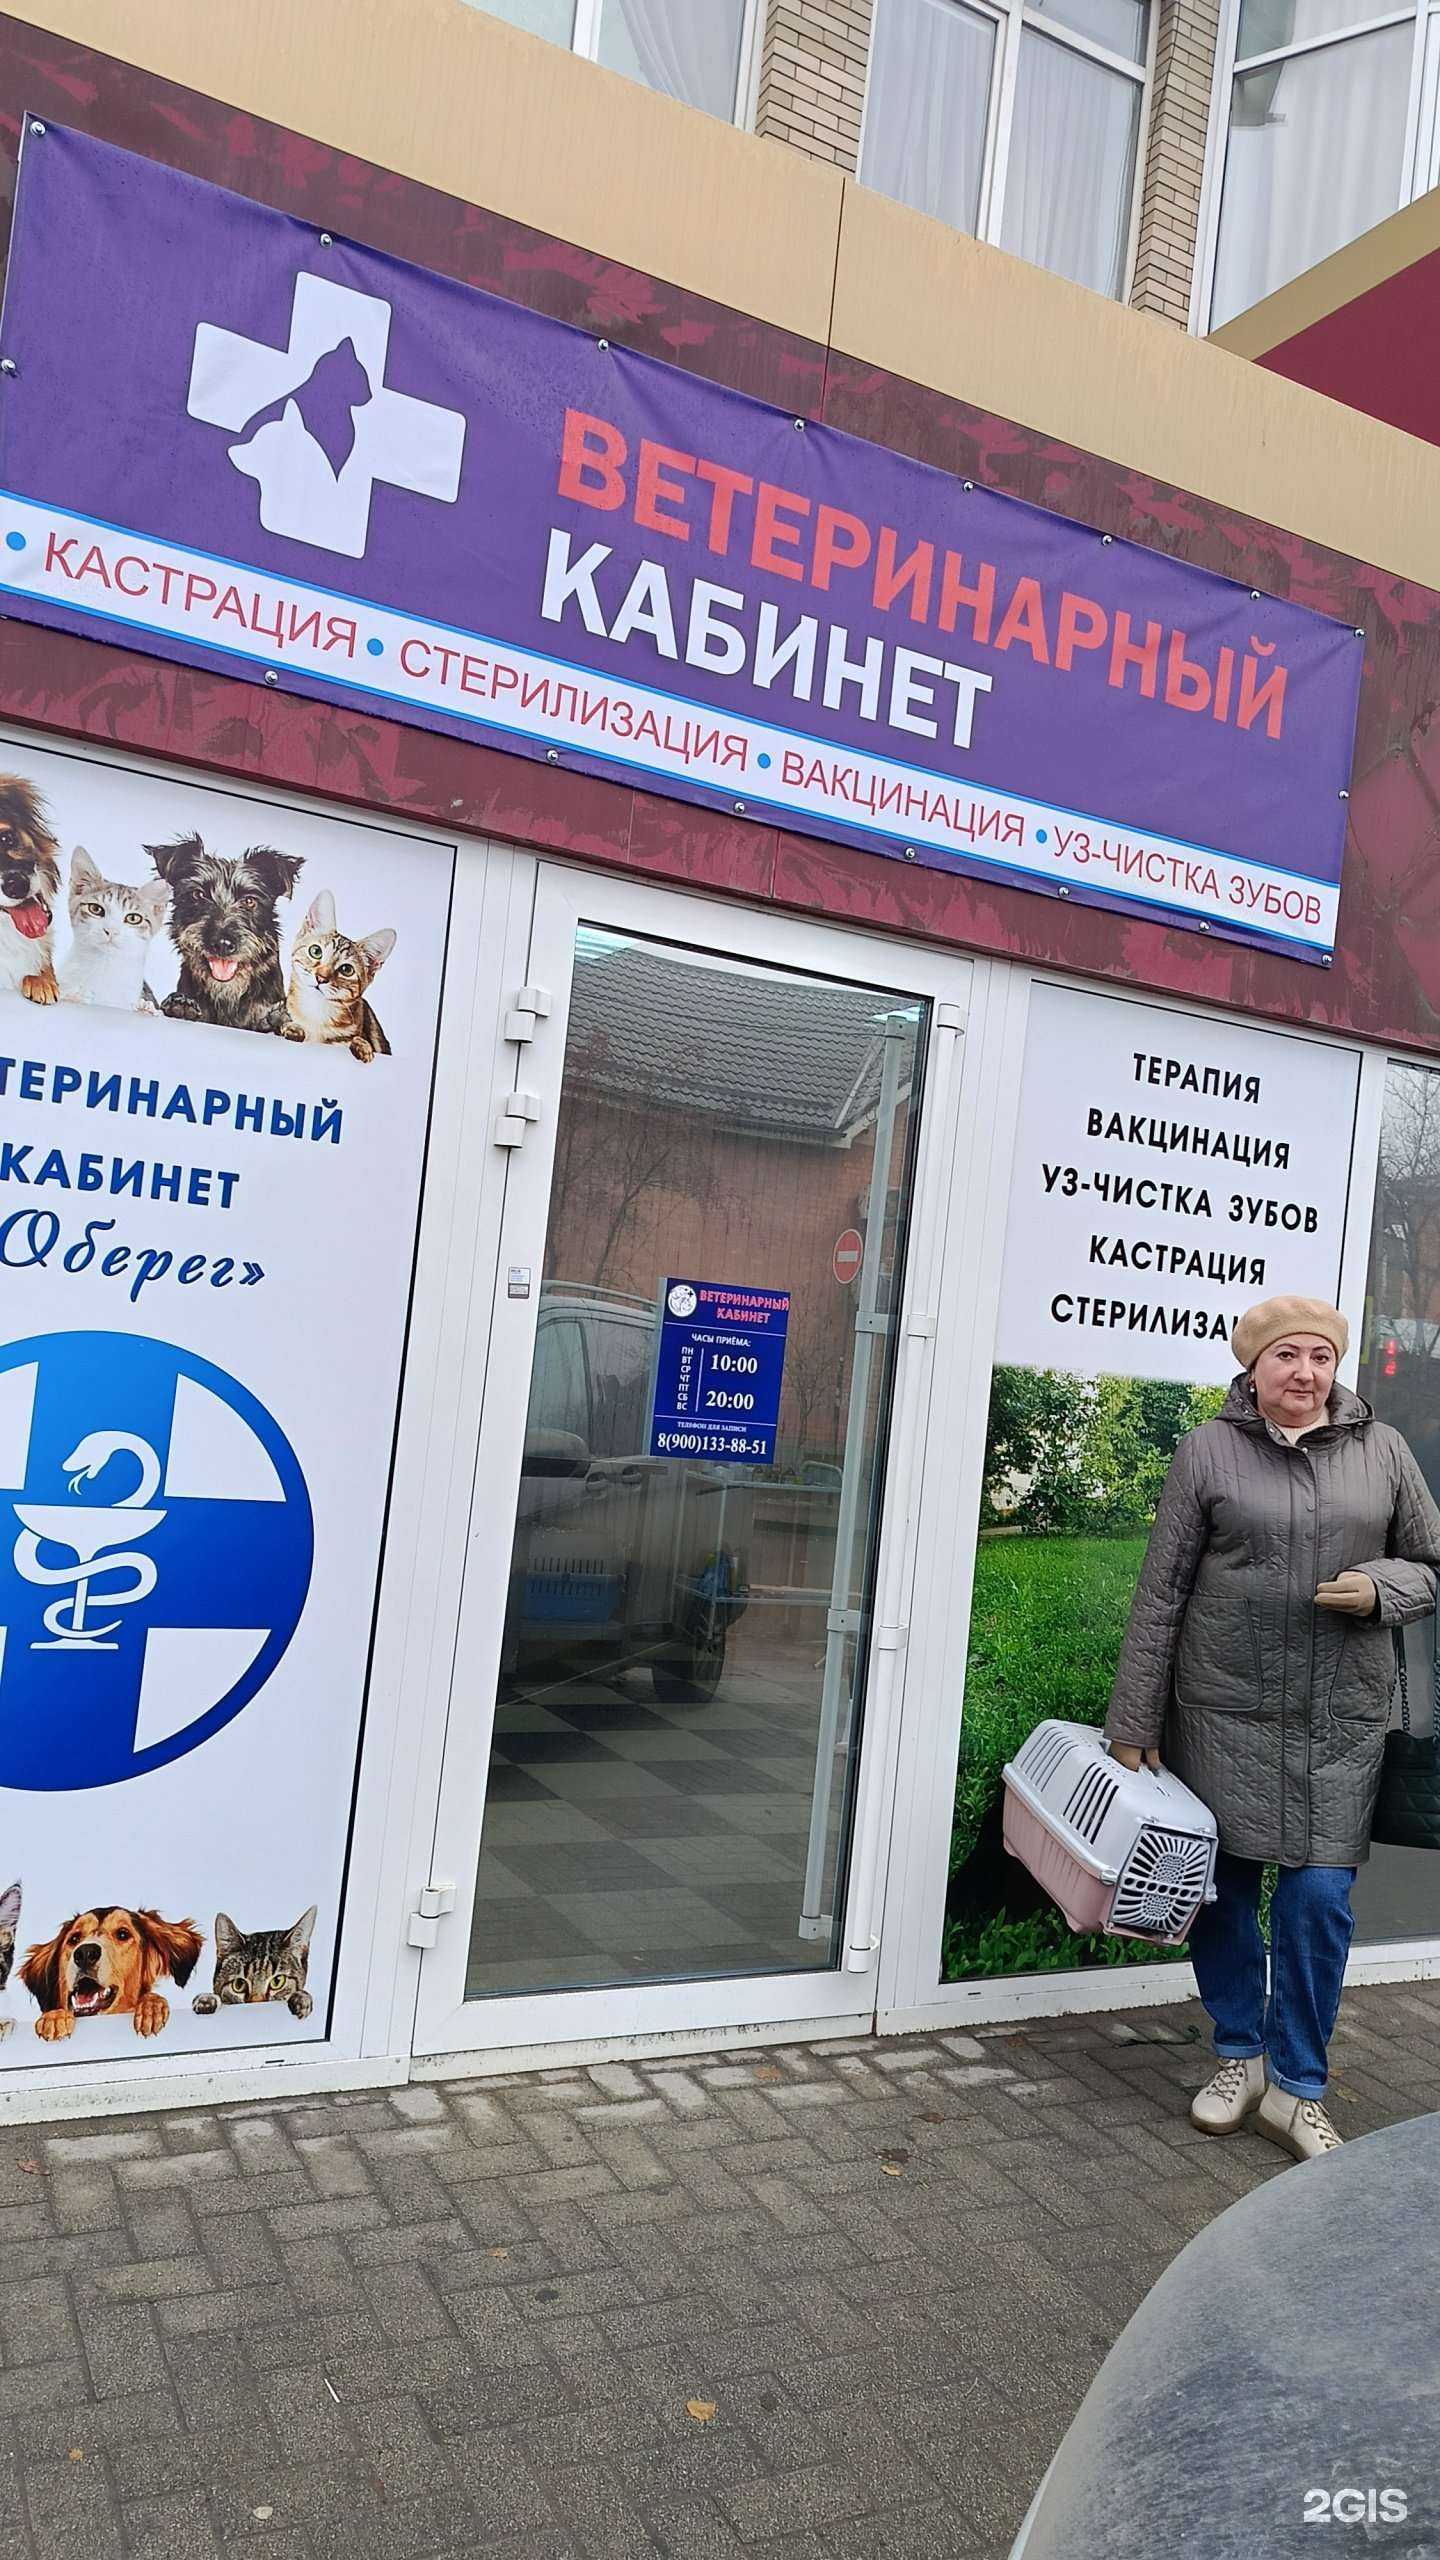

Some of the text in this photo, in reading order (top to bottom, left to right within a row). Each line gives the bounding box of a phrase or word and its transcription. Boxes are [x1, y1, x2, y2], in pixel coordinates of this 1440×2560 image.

[558, 408, 1288, 740] ВЕТЕРИНАРНЫЙ
[541, 527, 993, 749] КАБИНЕТ
[44, 532, 1322, 926] КАСТРАЦИЯ СТЕРИЛИЗАЦИЯ ВАКЦИНАЦИЯ УЗ-ЧИСТКА ЗУБОВ
[1133, 1053, 1261, 1104] ТЕРАПИЯ
[1087, 1108, 1291, 1170] ВАКЦИНАЦИЯ
[0, 1142, 240, 1209] КАБИНЕТ
[1041, 1164, 1318, 1233] УЗ-ЧИСТКА ЗУБОВ
[0, 1209, 266, 1302] Оберег»
[1089, 1235, 1266, 1286] КАСТРАЦИЯ
[699, 1290, 790, 1311] ВЕТЕРИНАРНЫЙ
[716, 1307, 771, 1324] КАБИНЕТ
[1050, 1294, 1239, 1342] СТЕРИЛИЗА
[691, 1332, 752, 1347] ЧАСЫ ПРИЁМА:
[681, 1346, 694, 1356] ПН
[681, 1356, 693, 1365] ВТ
[680, 1365, 692, 1374] СР
[710, 1354, 758, 1374] 10:00
[678, 1383, 690, 1392] ПТ
[679, 1374, 691, 1383] ЧТ
[676, 1401, 688, 1411] ВС
[677, 1393, 689, 1401] СБ
[705, 1391, 755, 1410] 20:00
[657, 1432, 767, 1455] 8(900)133-88-51
